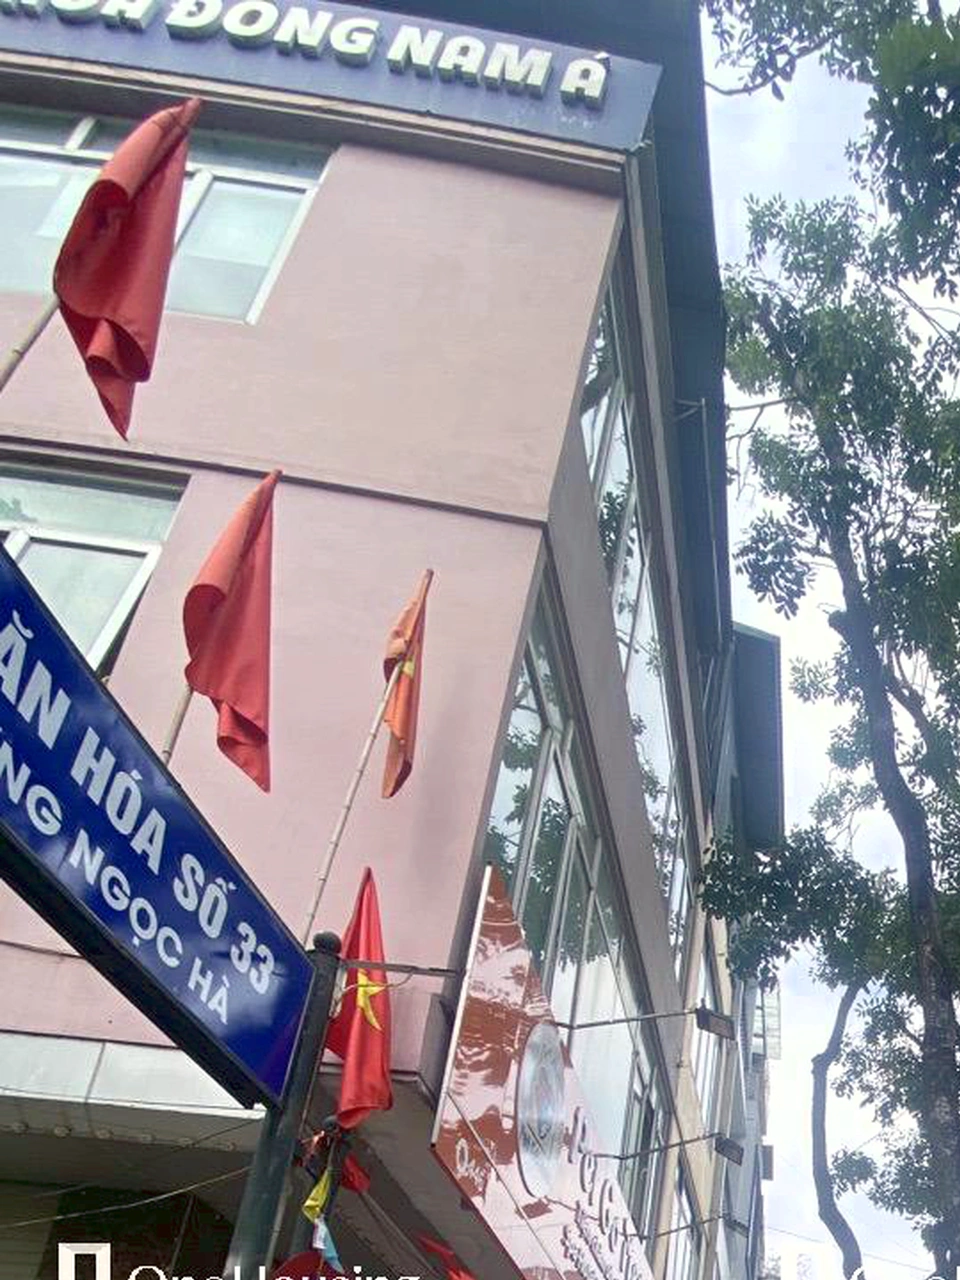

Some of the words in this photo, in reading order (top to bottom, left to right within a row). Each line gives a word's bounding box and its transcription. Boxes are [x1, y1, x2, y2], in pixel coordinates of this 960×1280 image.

[386, 24, 551, 97] NAM
[559, 51, 611, 110] Á
[69, 829, 182, 968] NGỌC
[188, 957, 231, 1025] HÀ
[71, 726, 167, 875] HÓA
[173, 853, 237, 939] SỐ
[231, 922, 275, 994] 33
